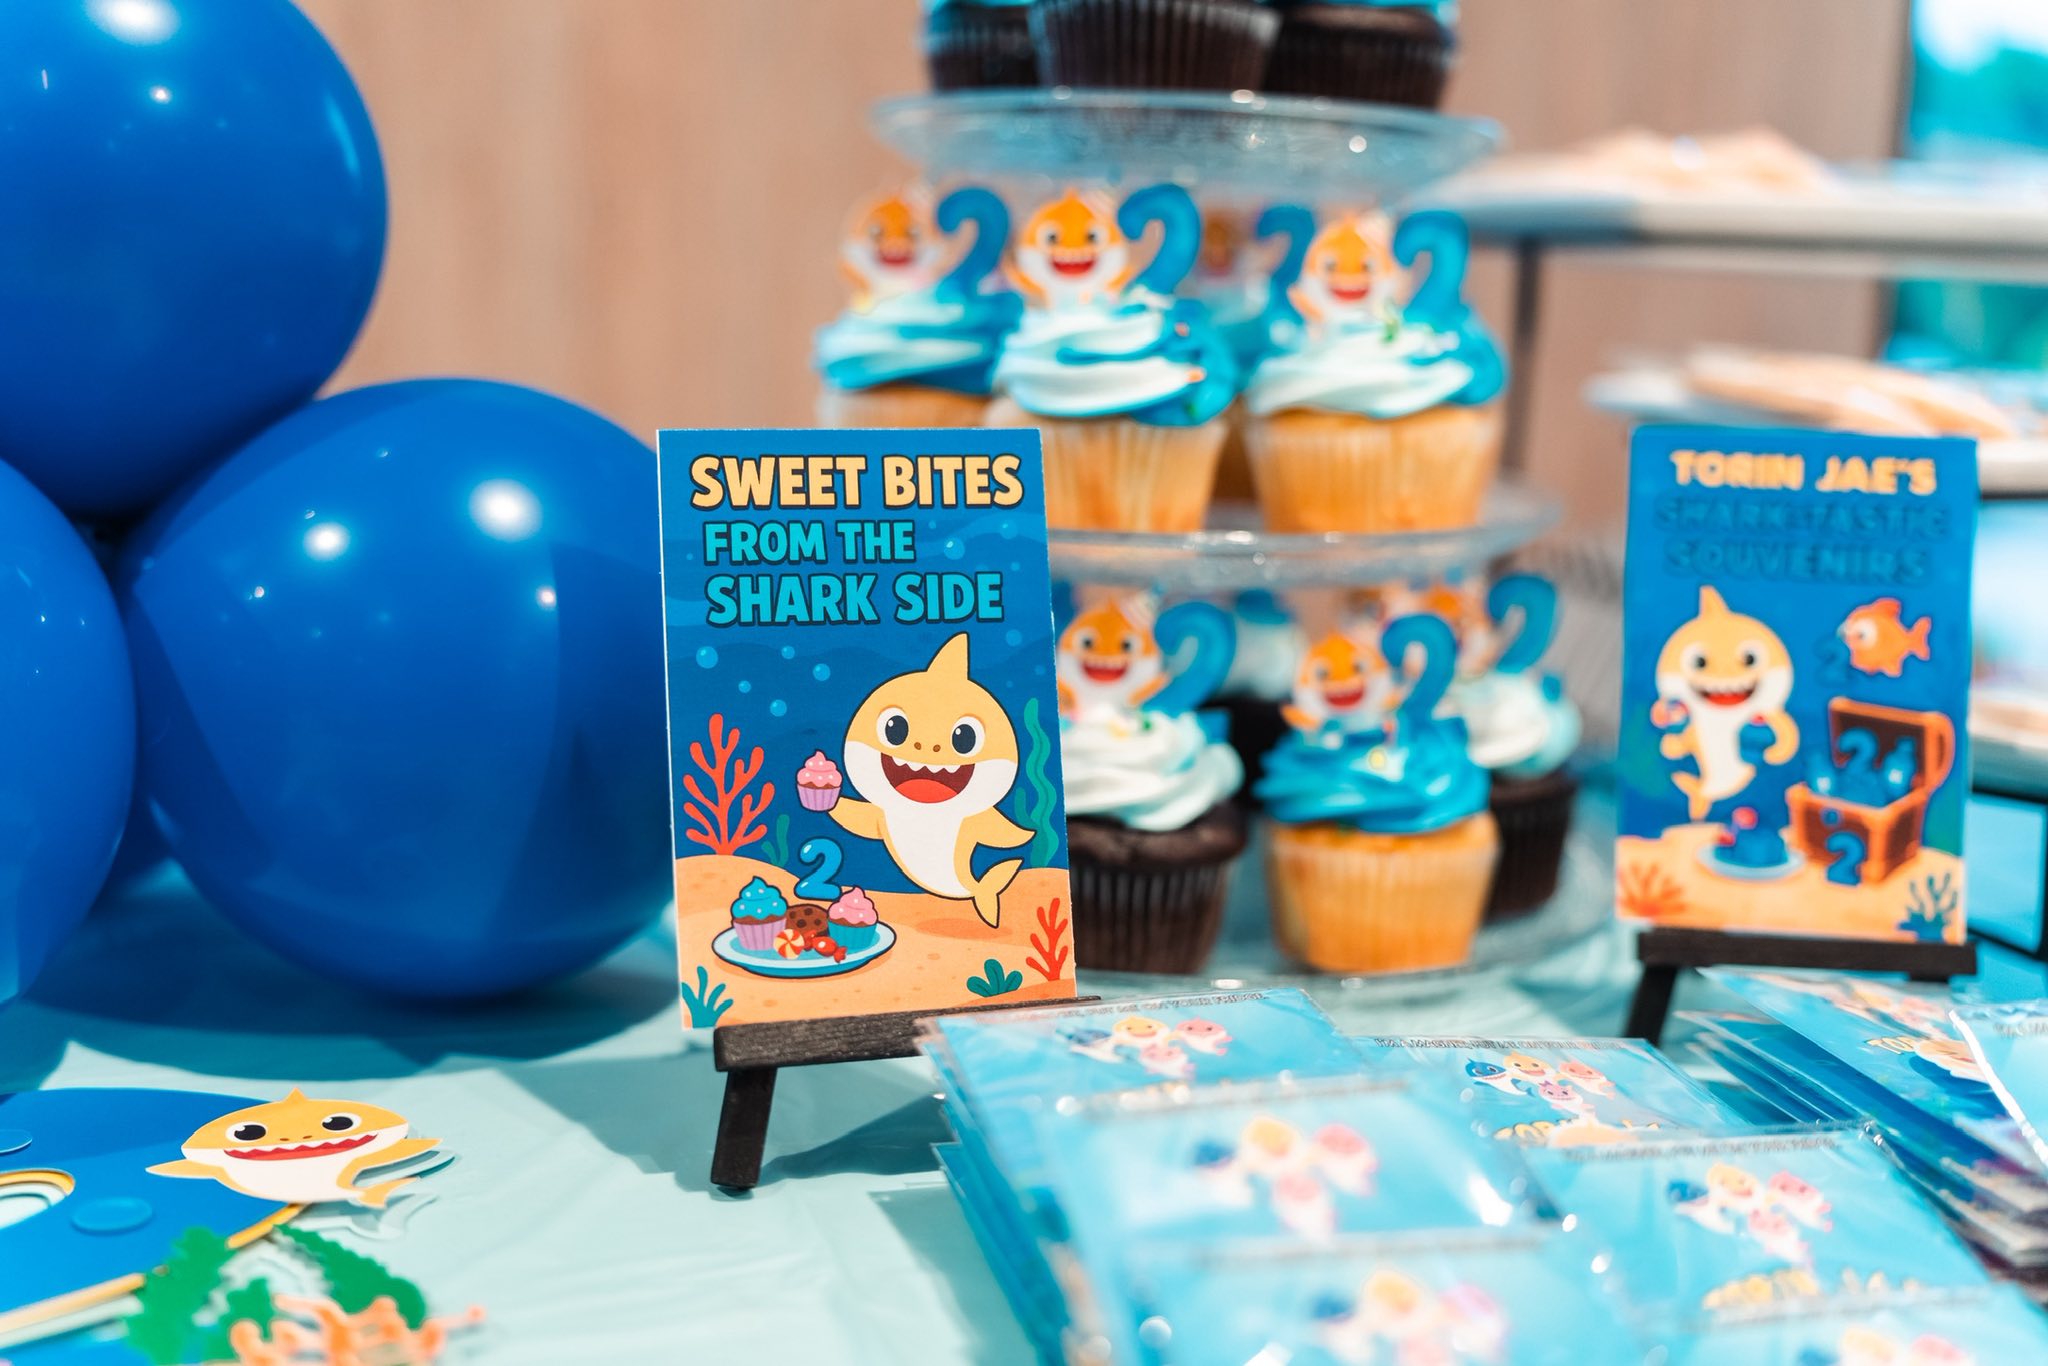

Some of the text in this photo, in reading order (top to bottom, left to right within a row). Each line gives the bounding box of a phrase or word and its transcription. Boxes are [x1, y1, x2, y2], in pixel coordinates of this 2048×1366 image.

[689, 453, 1025, 510] SWEET BITES
[1669, 450, 1937, 496] TORIN JAE'S
[702, 519, 917, 567] FROM THE
[705, 570, 1005, 629] SHARK SIDE
[794, 836, 843, 901] 2
